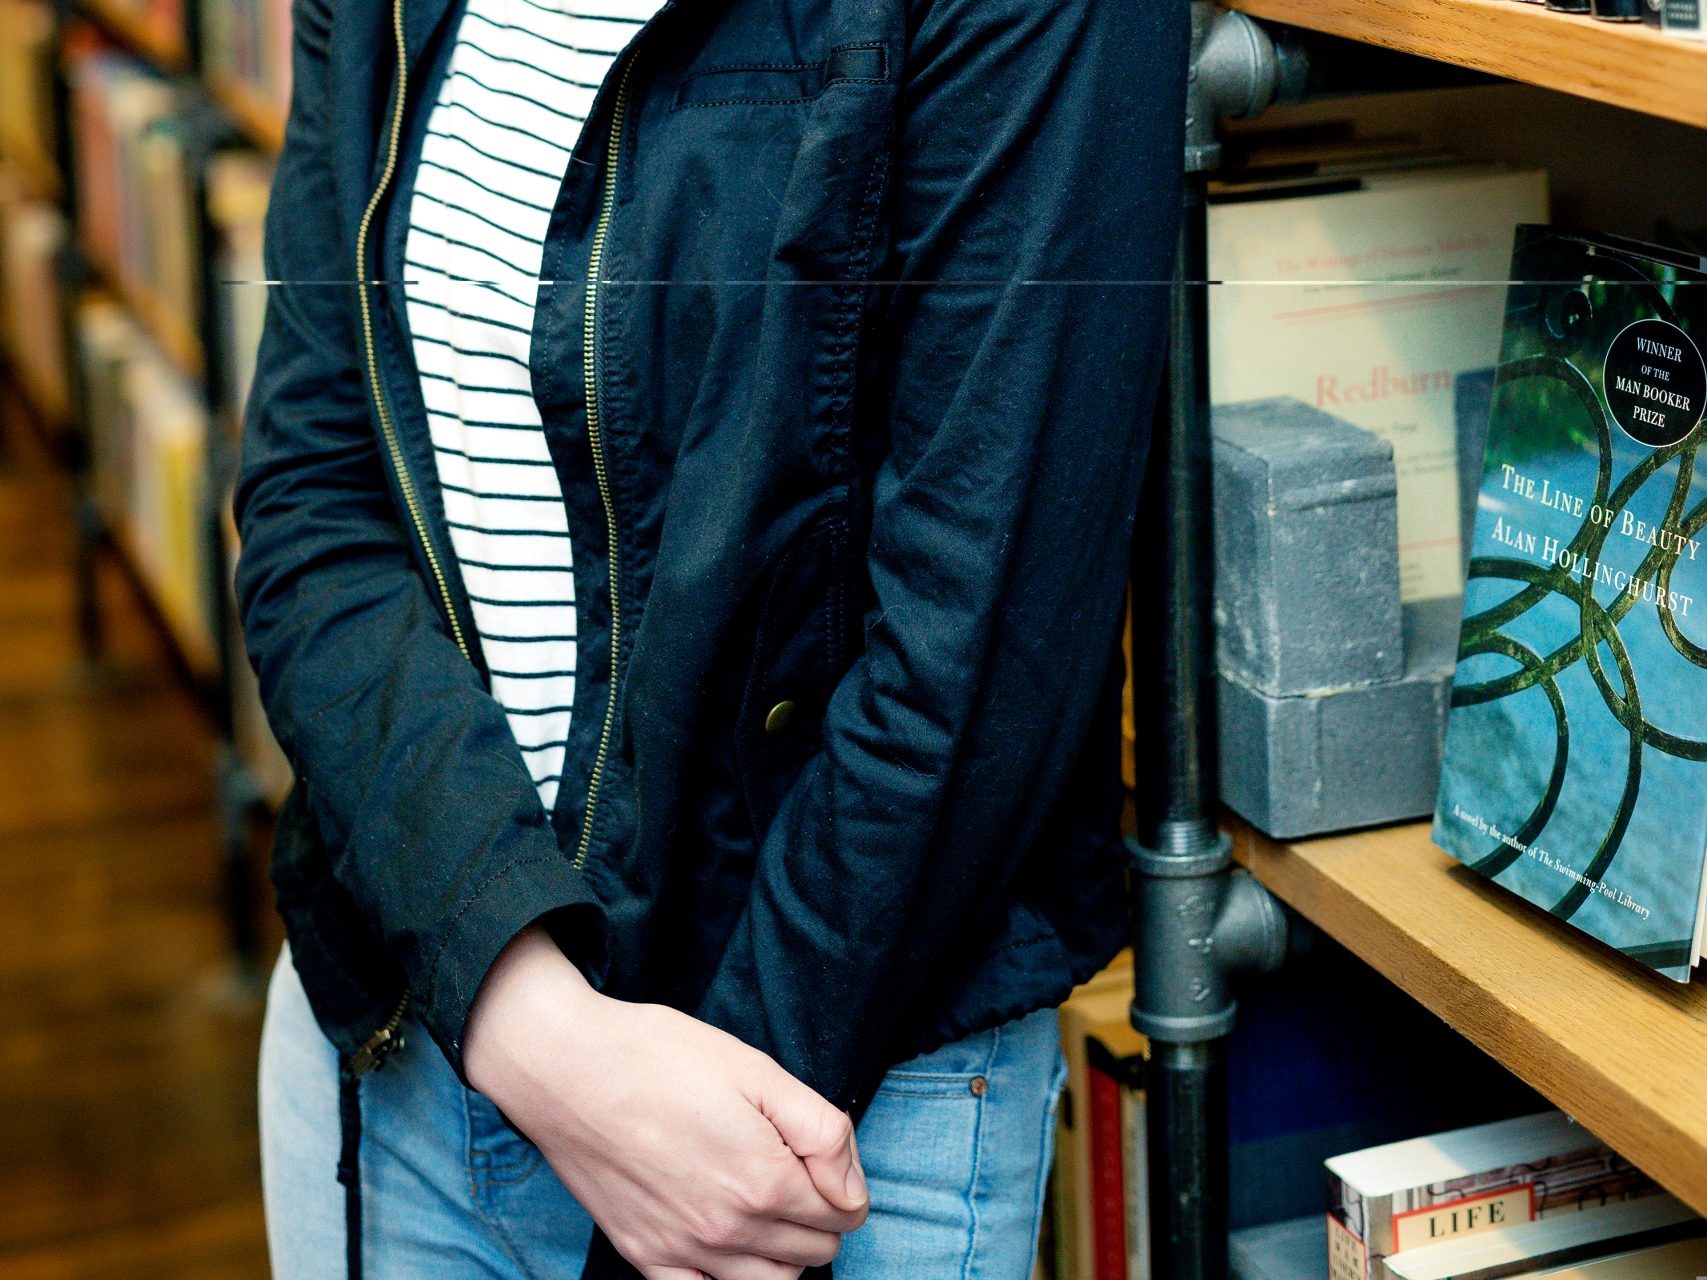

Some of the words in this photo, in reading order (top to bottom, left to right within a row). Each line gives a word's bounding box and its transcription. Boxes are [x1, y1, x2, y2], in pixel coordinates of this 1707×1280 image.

[1636, 336, 1682, 363] WINNER
[1315, 366, 1453, 410] Redburn
[1641, 364, 1653, 376] OF
[1653, 367, 1670, 382] THE
[1615, 375, 1641, 396] MAN
[1642, 384, 1691, 412] BOOKER
[1632, 405, 1666, 428] PRIZE
[1501, 463, 1536, 500] THE
[1540, 479, 1584, 519] LINE
[1590, 504, 1614, 528] OF
[1620, 509, 1701, 561] BEAUTY
[1491, 516, 1537, 555] ALAN
[1541, 535, 1693, 617] HOLLINGHURST
[1452, 803, 1460, 817] A
[1460, 810, 1480, 828] novel
[1479, 817, 1489, 836] by
[1489, 823, 1501, 840] the
[1501, 833, 1528, 854] author
[1528, 846, 1539, 859] of
[1538, 849, 1554, 867] The
[1553, 858, 1618, 901] Swimming-Pool
[1617, 891, 1651, 921] Library
[1429, 1199, 1506, 1239] LIFE
